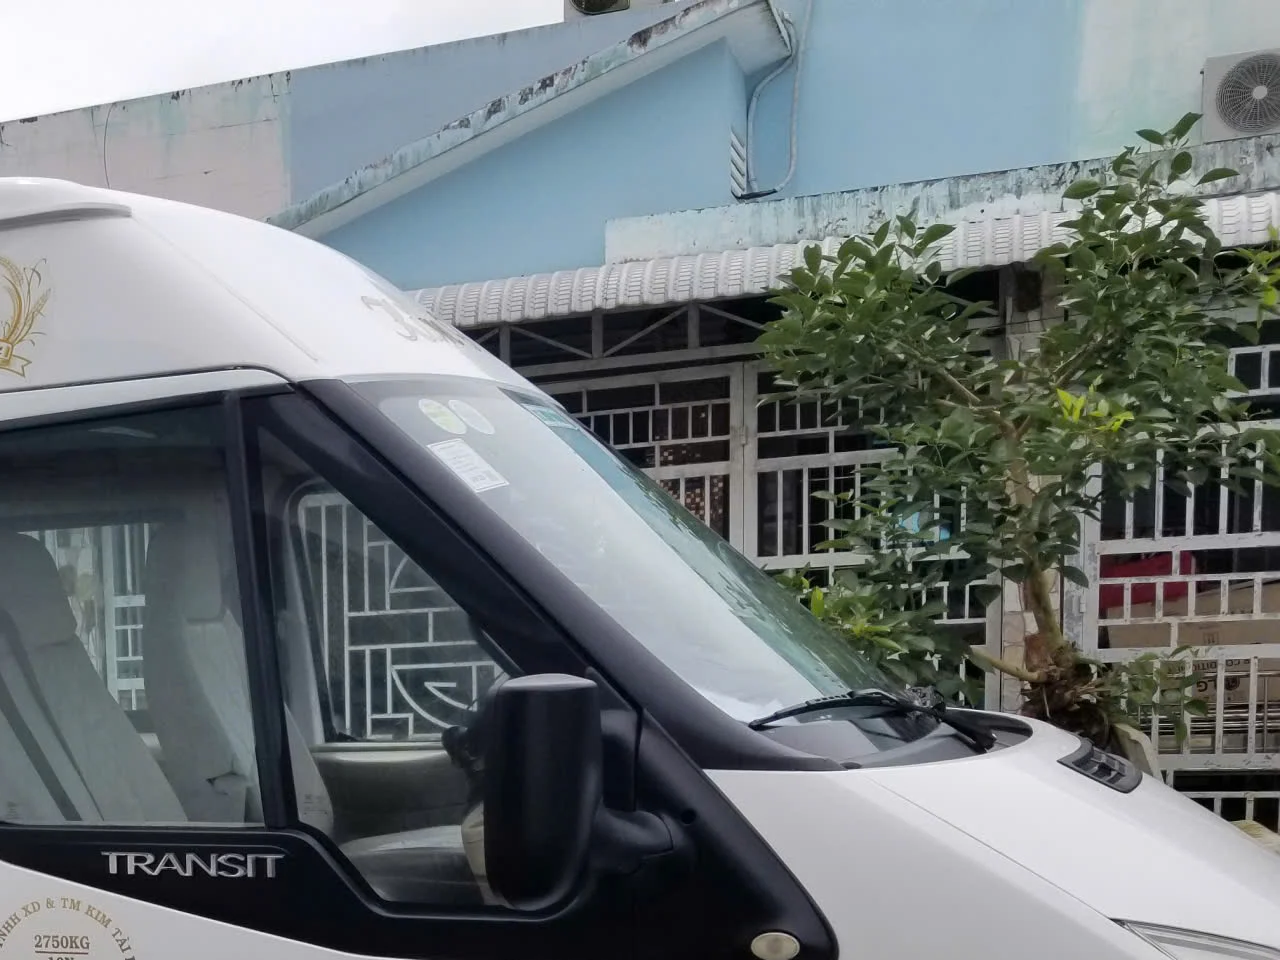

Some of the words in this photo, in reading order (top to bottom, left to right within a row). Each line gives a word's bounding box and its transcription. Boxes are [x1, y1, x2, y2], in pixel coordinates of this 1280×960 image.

[101, 851, 285, 878] TRANSIT
[22, 901, 41, 918] XD
[46, 898, 55, 909] &
[61, 898, 81, 911] TM
[84, 905, 113, 928] KIM
[111, 928, 132, 953] TÀI
[34, 935, 90, 950] 2750KG
